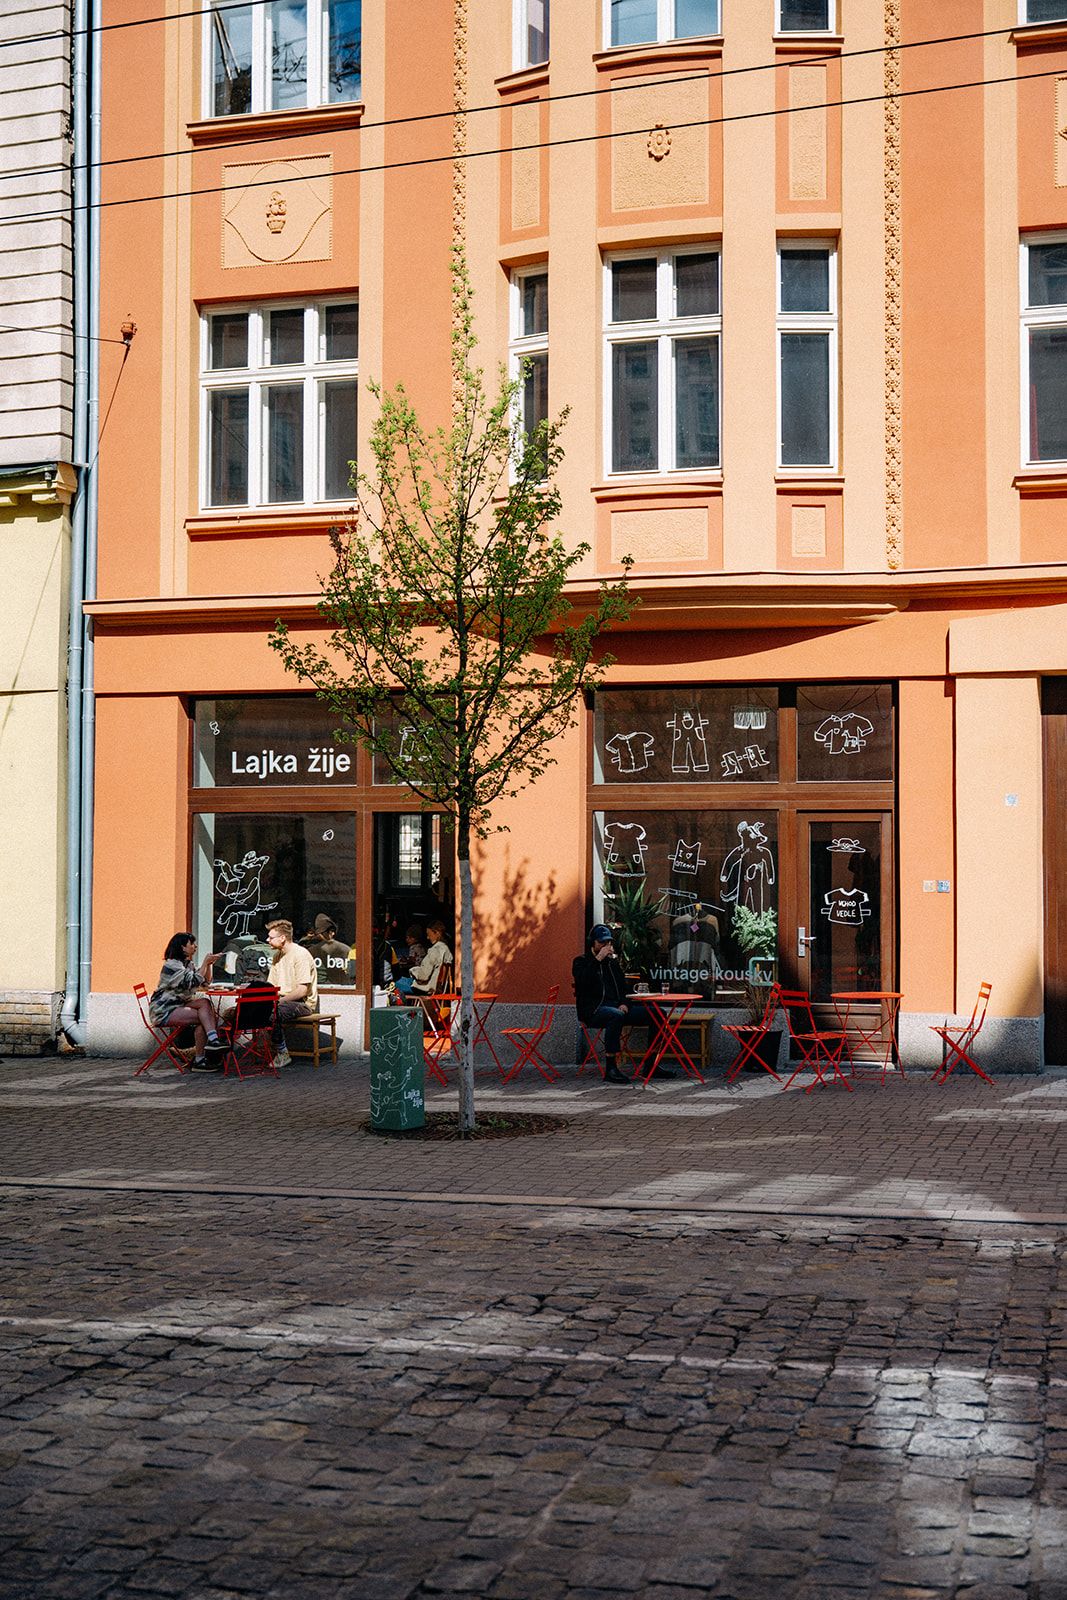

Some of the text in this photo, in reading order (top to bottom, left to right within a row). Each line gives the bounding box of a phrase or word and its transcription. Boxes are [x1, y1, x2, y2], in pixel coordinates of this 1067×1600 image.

[231, 747, 351, 779] Lajka žije
[836, 909, 857, 917] VEDLE
[326, 954, 350, 969] bar
[649, 966, 773, 983] vintage kousky
